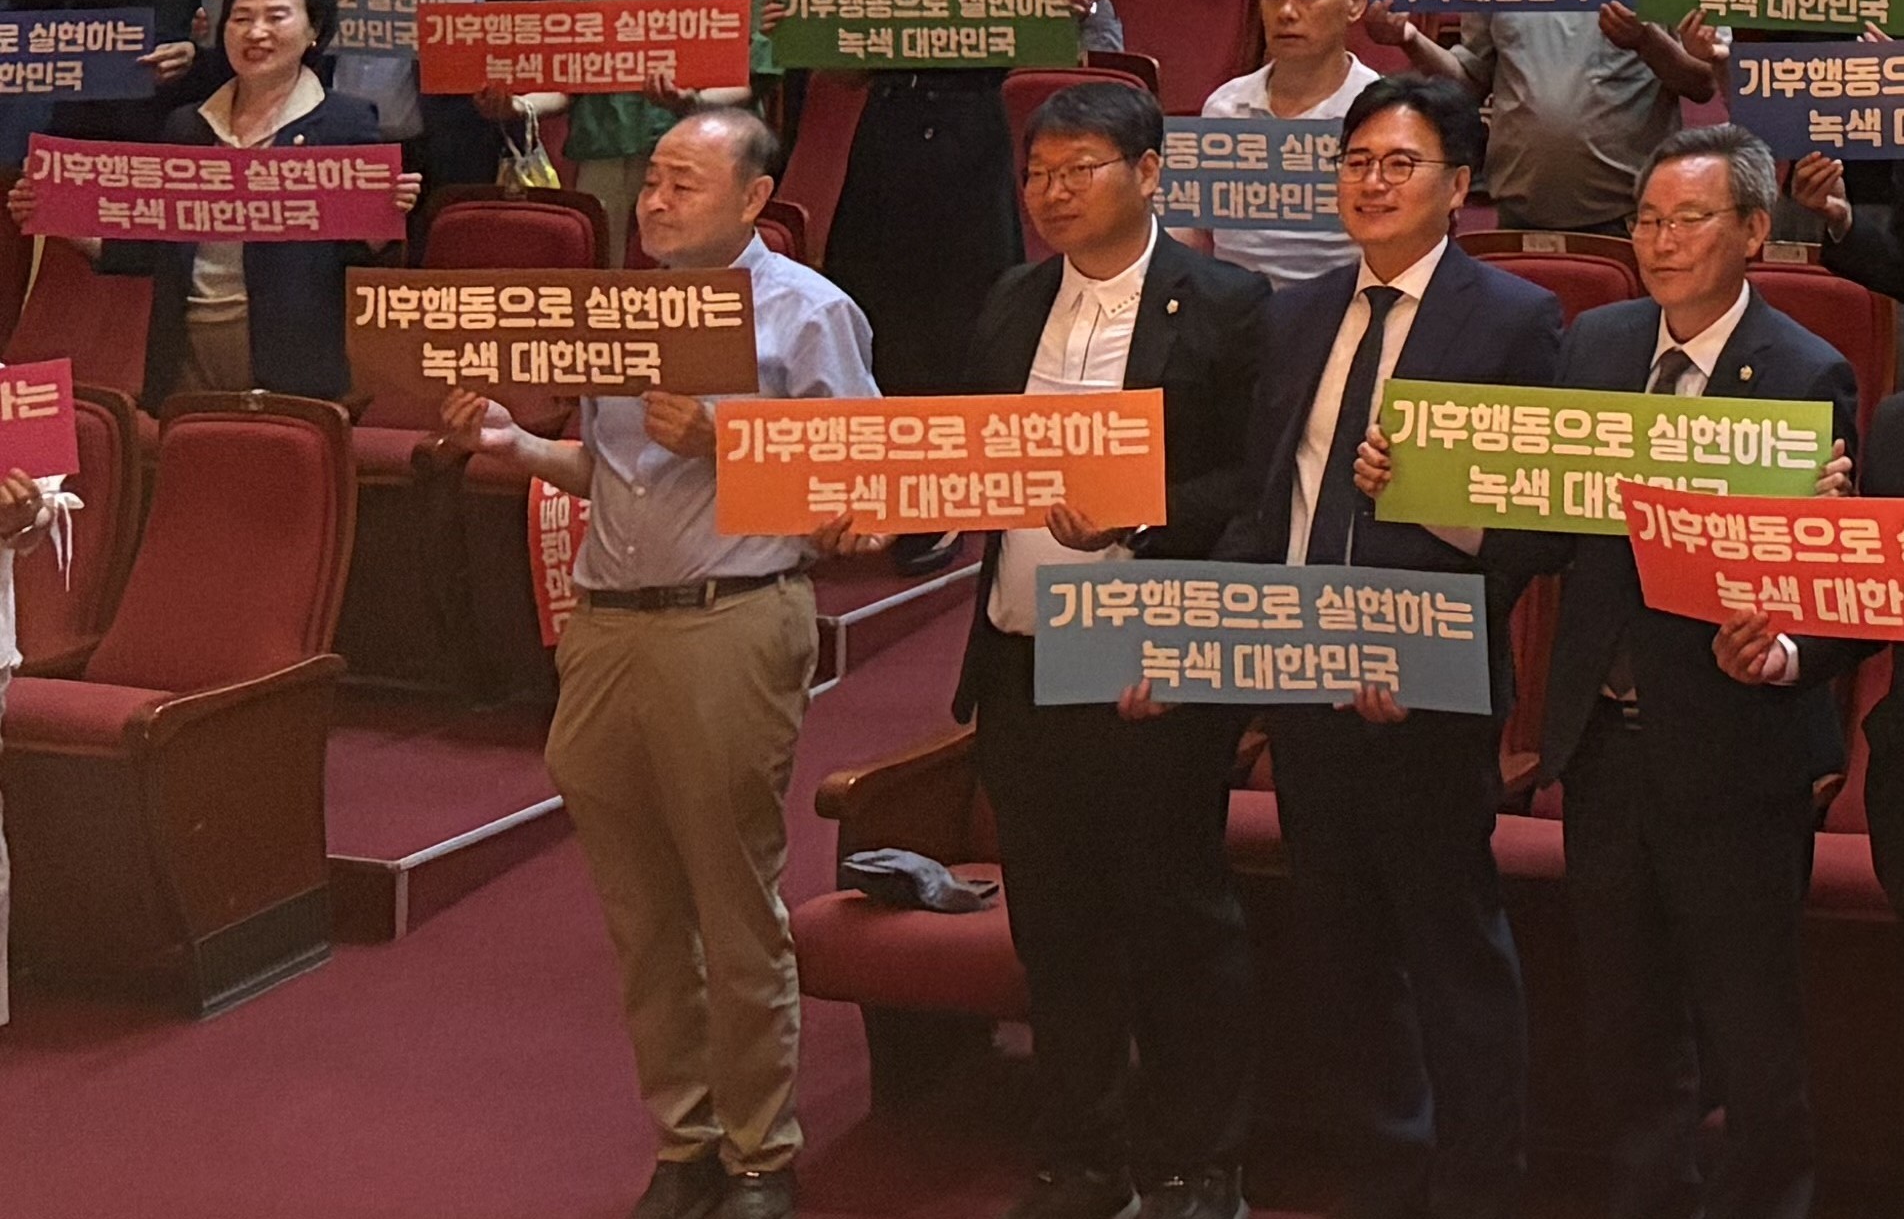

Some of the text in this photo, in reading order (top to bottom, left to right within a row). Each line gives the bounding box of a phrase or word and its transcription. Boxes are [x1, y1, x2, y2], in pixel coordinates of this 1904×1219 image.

[426, 8, 740, 45] 기후행동으로 실현하는
[838, 26, 1015, 58] 녹색 대한민국
[486, 50, 677, 84] 녹색 대한민국
[1809, 108, 1881, 147] 녹색
[33, 149, 391, 191] 기후행동으로 실현하는
[98, 197, 319, 232] 녹색 대한민국
[356, 286, 742, 329] 기후행동으로 실현하는
[422, 340, 661, 384] 녹색 대한민국
[728, 411, 1150, 462] 기후행동으로 실현하는
[1391, 400, 1818, 469] 기후행동으로 실현하는
[808, 471, 1065, 519] 녹색 대한민국
[1468, 465, 1549, 515] 녹색
[1638, 501, 1884, 563] 기후행동으로
[1049, 578, 1473, 639] 기후행동으로 실현하는
[1716, 572, 1803, 620] 녹색
[1141, 640, 1399, 691] 녹색 대한민국
